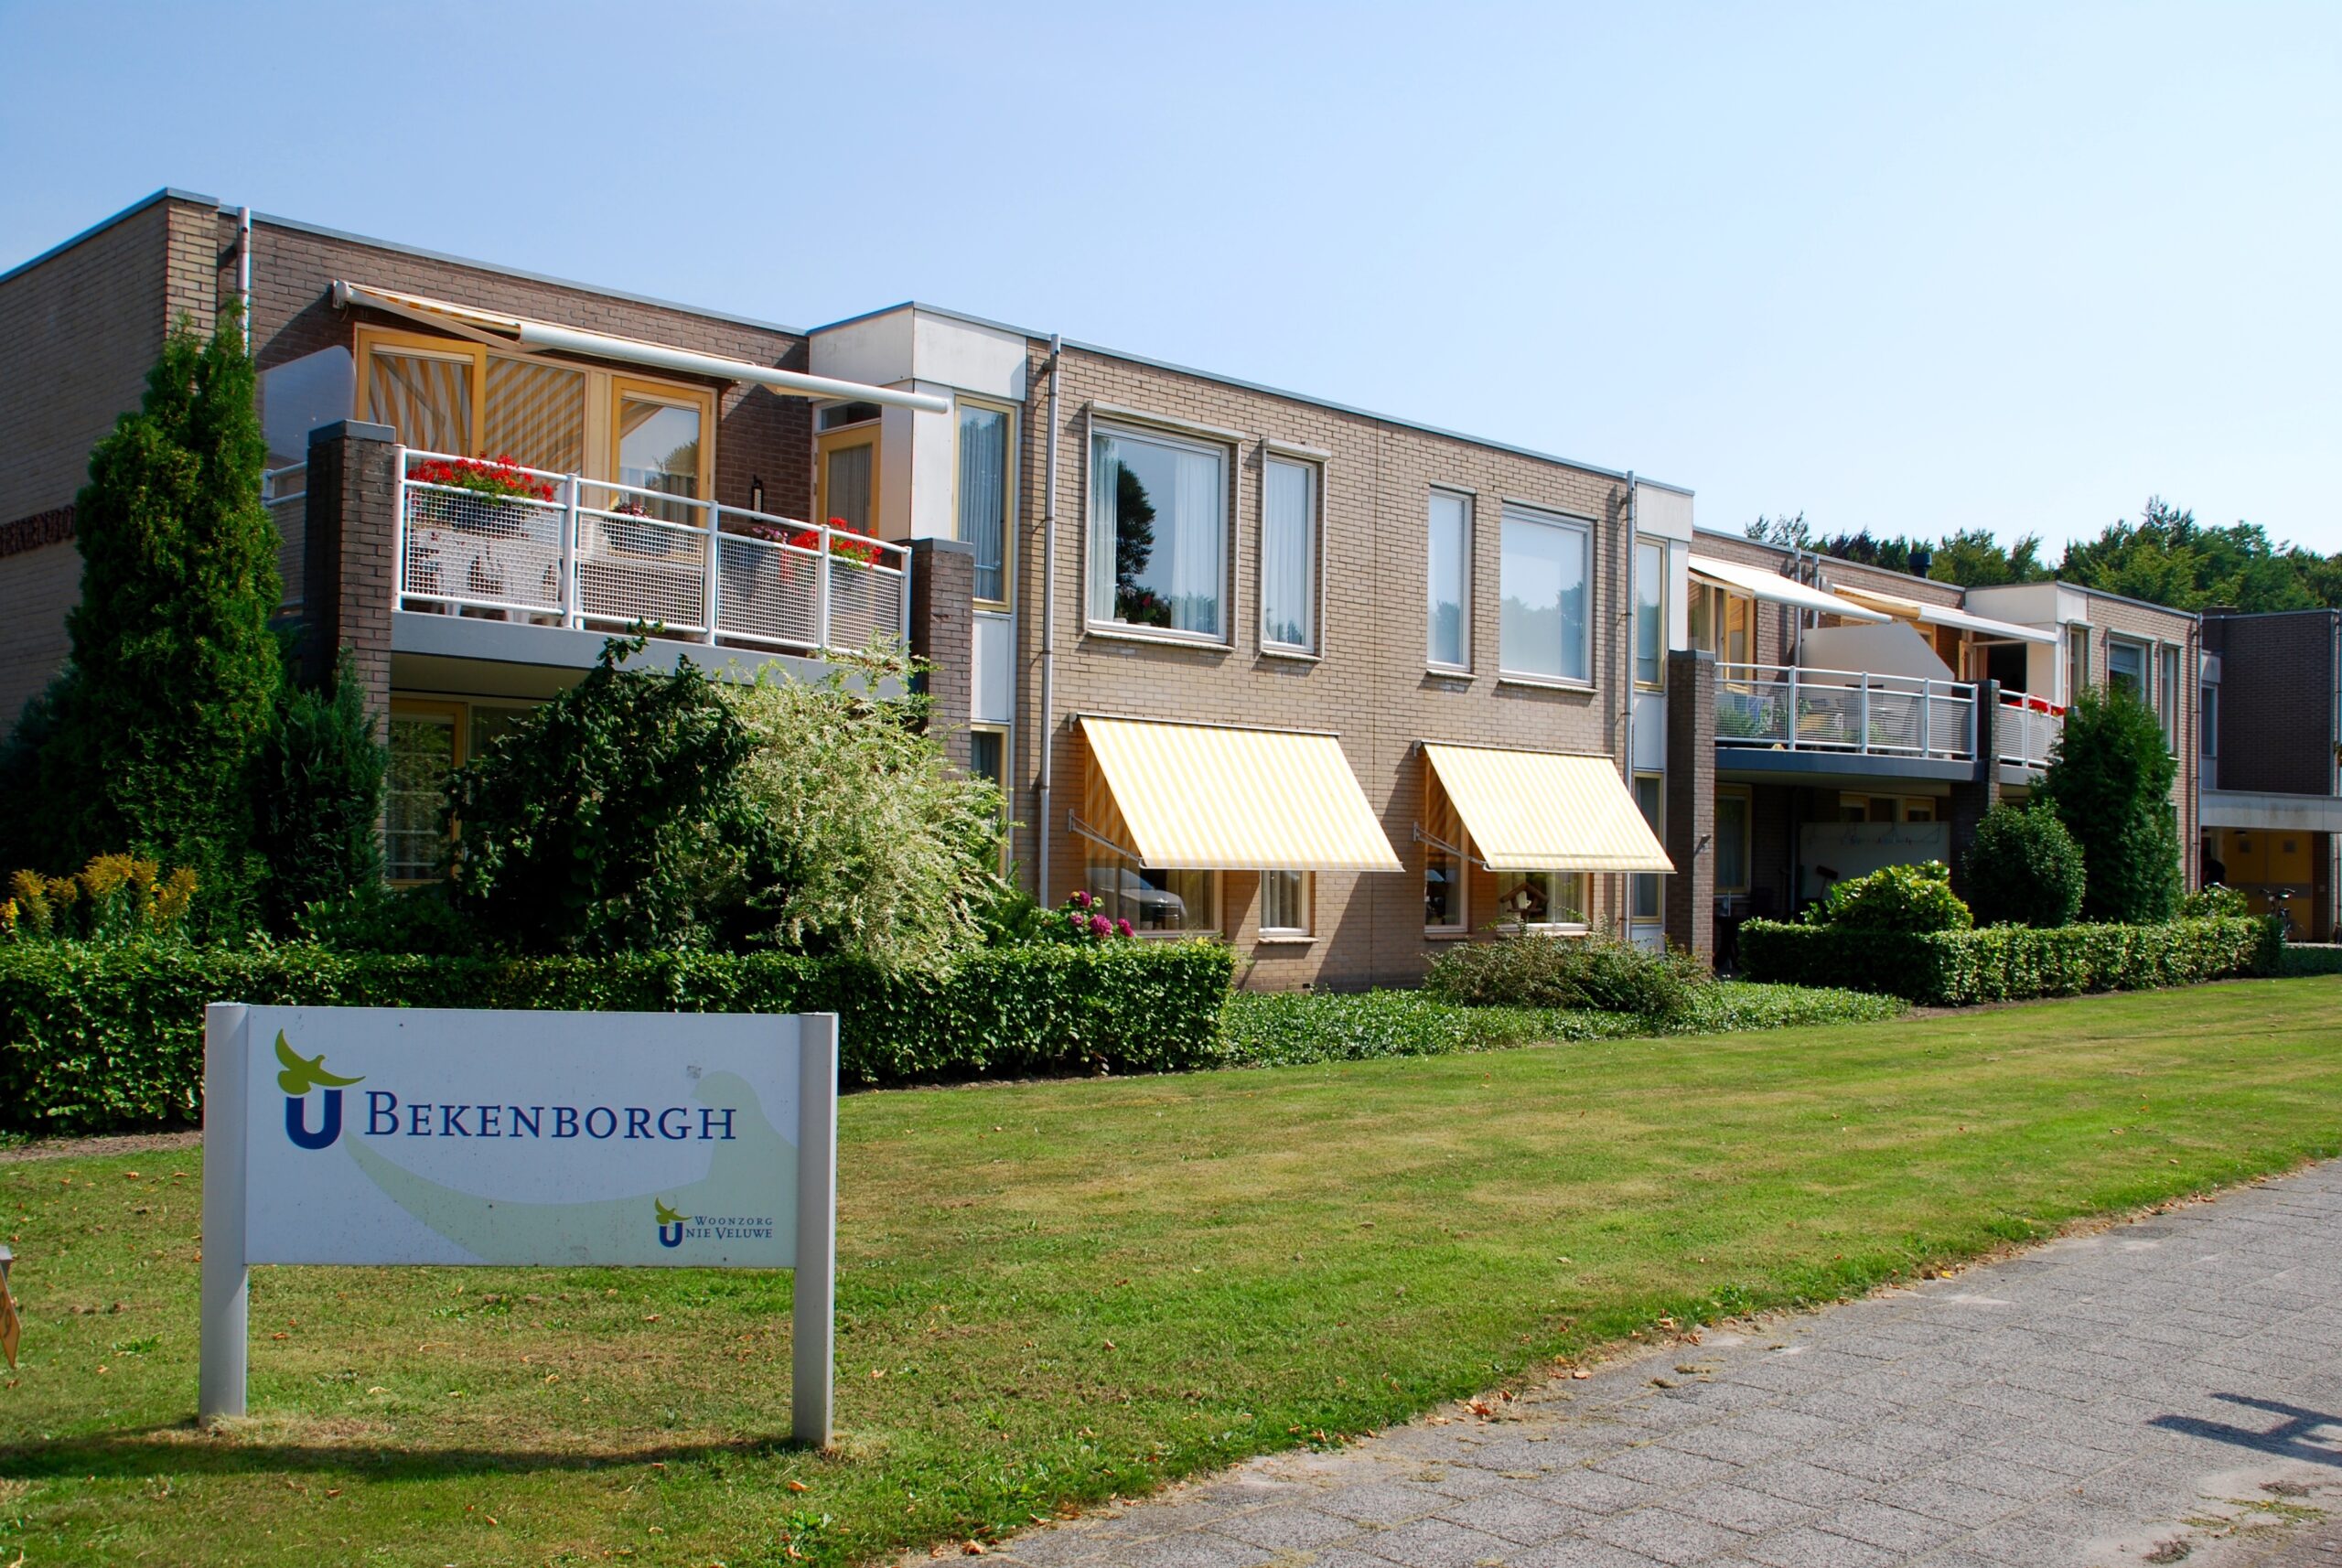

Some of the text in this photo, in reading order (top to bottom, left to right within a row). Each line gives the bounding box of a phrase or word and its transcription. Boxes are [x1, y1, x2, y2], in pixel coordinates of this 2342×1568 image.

[364, 1090, 737, 1141] BEKENBORGH
[695, 1216, 773, 1226] WOONZORG
[715, 1227, 773, 1240] VELUWE
